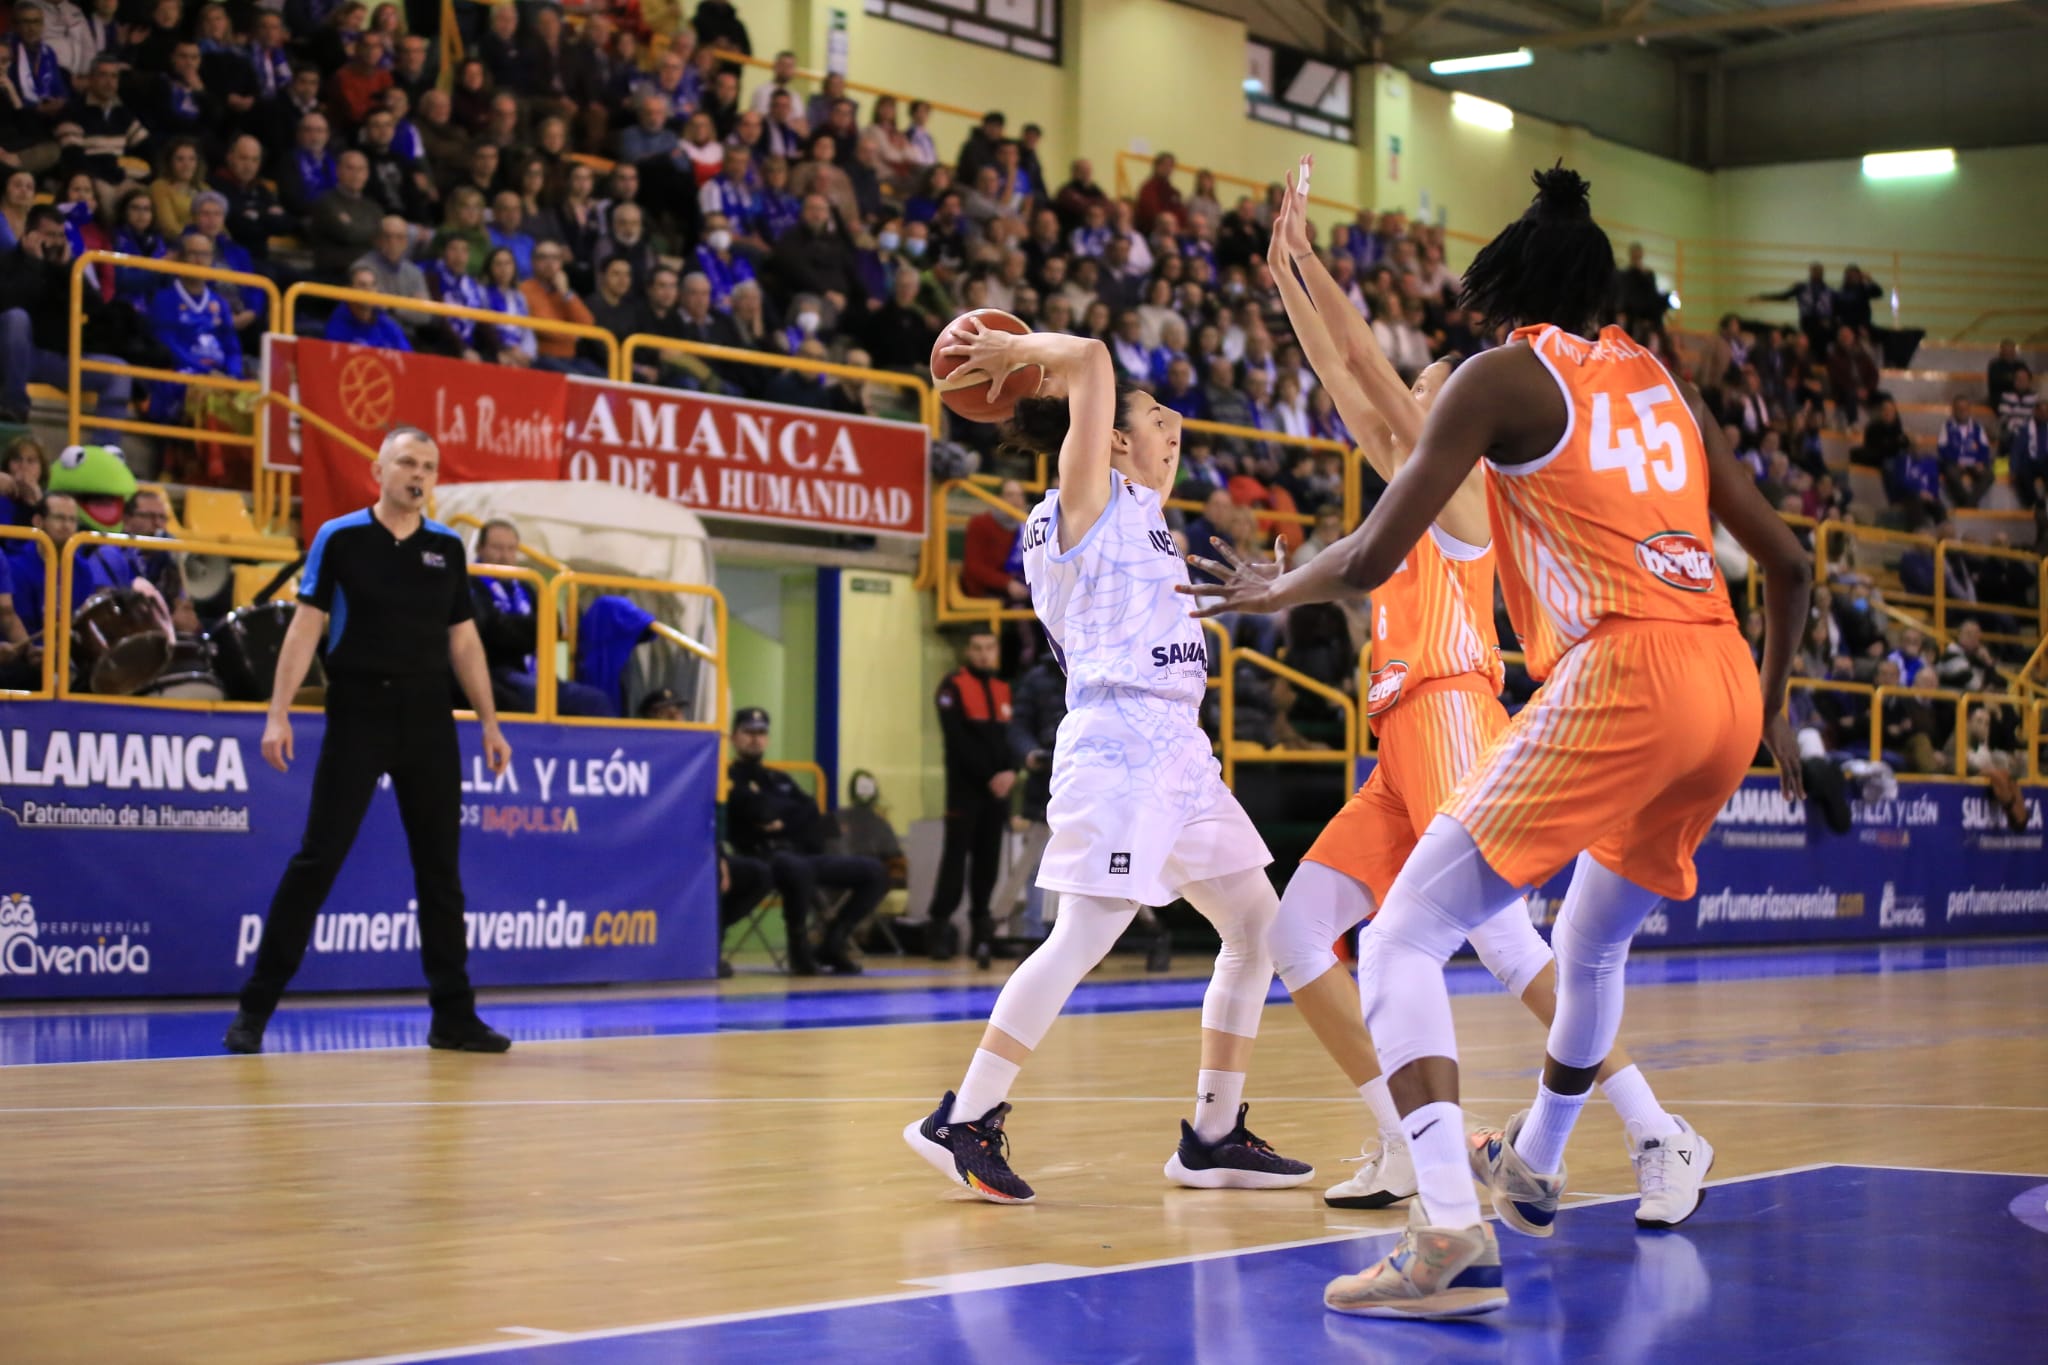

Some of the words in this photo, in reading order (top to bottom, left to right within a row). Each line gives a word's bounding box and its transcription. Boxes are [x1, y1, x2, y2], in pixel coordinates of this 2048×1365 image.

[436, 386, 468, 444] La
[566, 392, 862, 475] AMANCA
[1588, 384, 1687, 493] 45
[608, 453, 656, 494] DE
[667, 461, 710, 506] LA
[718, 467, 912, 526] HUMANIDAD
[533, 757, 558, 802] Y
[568, 747, 650, 796] LEÓN
[23, 800, 113, 825] Patrimonio
[119, 803, 139, 826] de
[142, 804, 158, 826] la
[160, 804, 249, 828] Humanidad
[5, 933, 150, 976] avenida
[40, 920, 151, 936] PERFUMERÍAS
